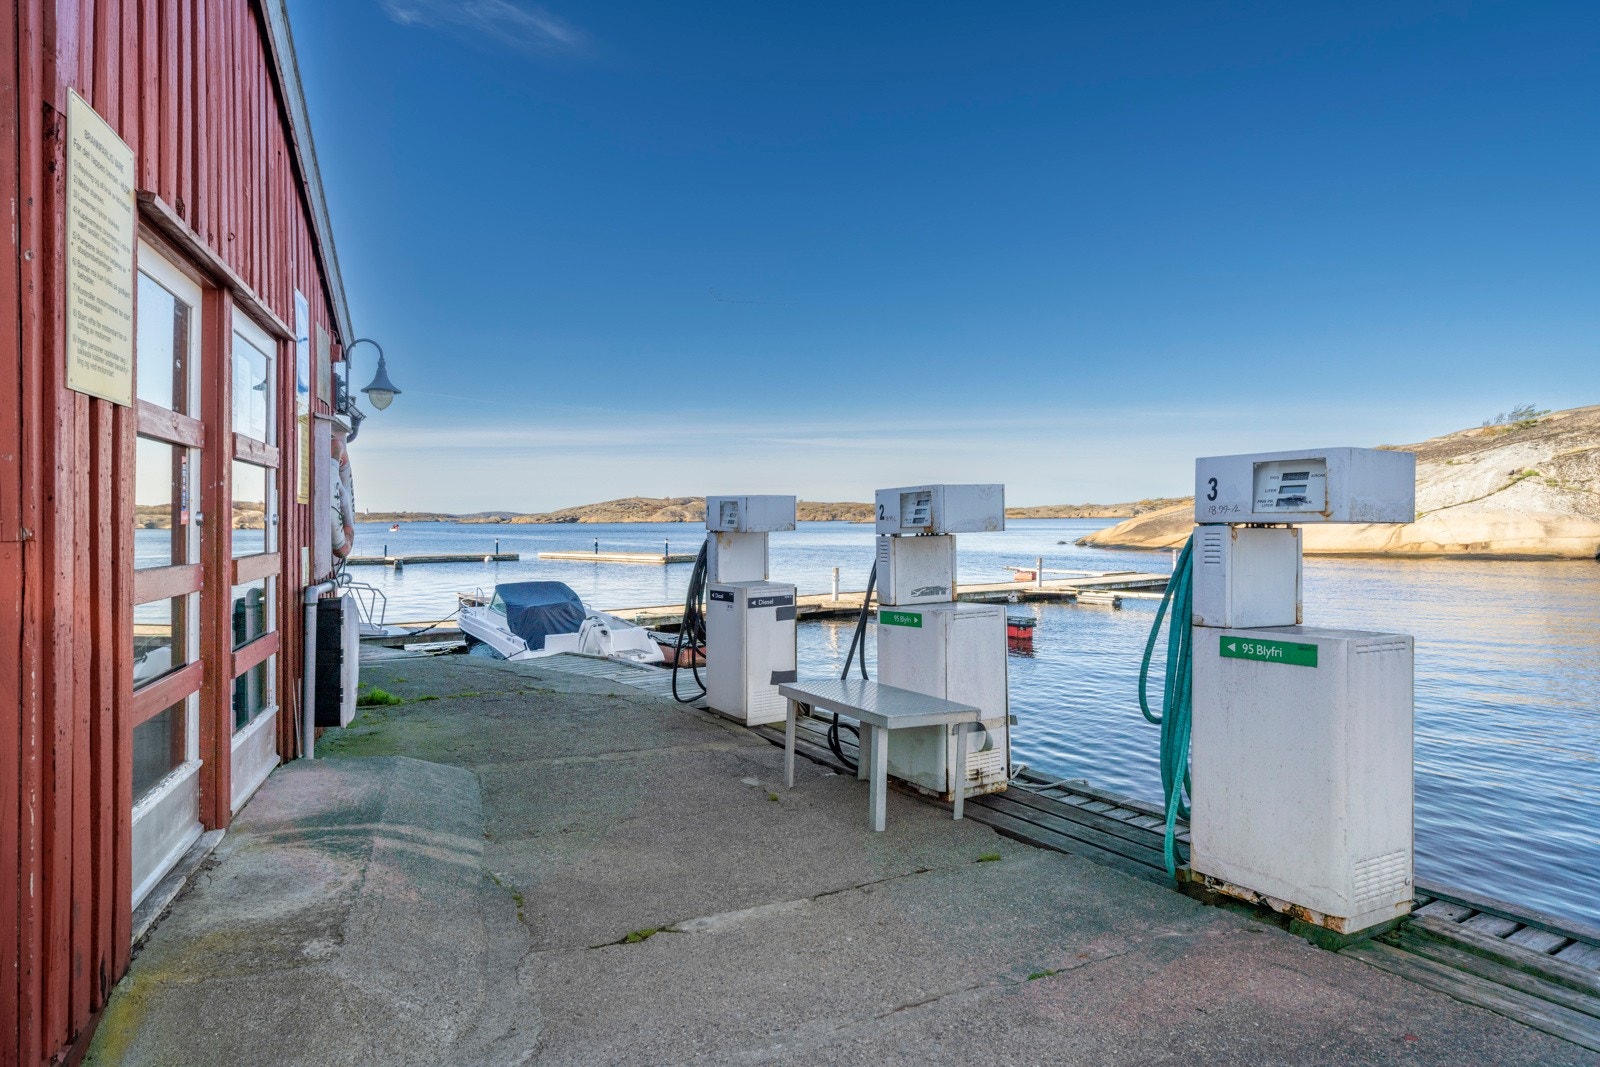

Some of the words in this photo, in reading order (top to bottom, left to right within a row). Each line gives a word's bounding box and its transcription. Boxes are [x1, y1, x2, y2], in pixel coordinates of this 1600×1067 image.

[1207, 477, 1218, 501] 3
[879, 504, 885, 520] 2
[894, 614, 899, 622] 95
[900, 615, 912, 624] Blyfri
[1242, 643, 1254, 654] 95
[1256, 645, 1282, 659] Blyfri
